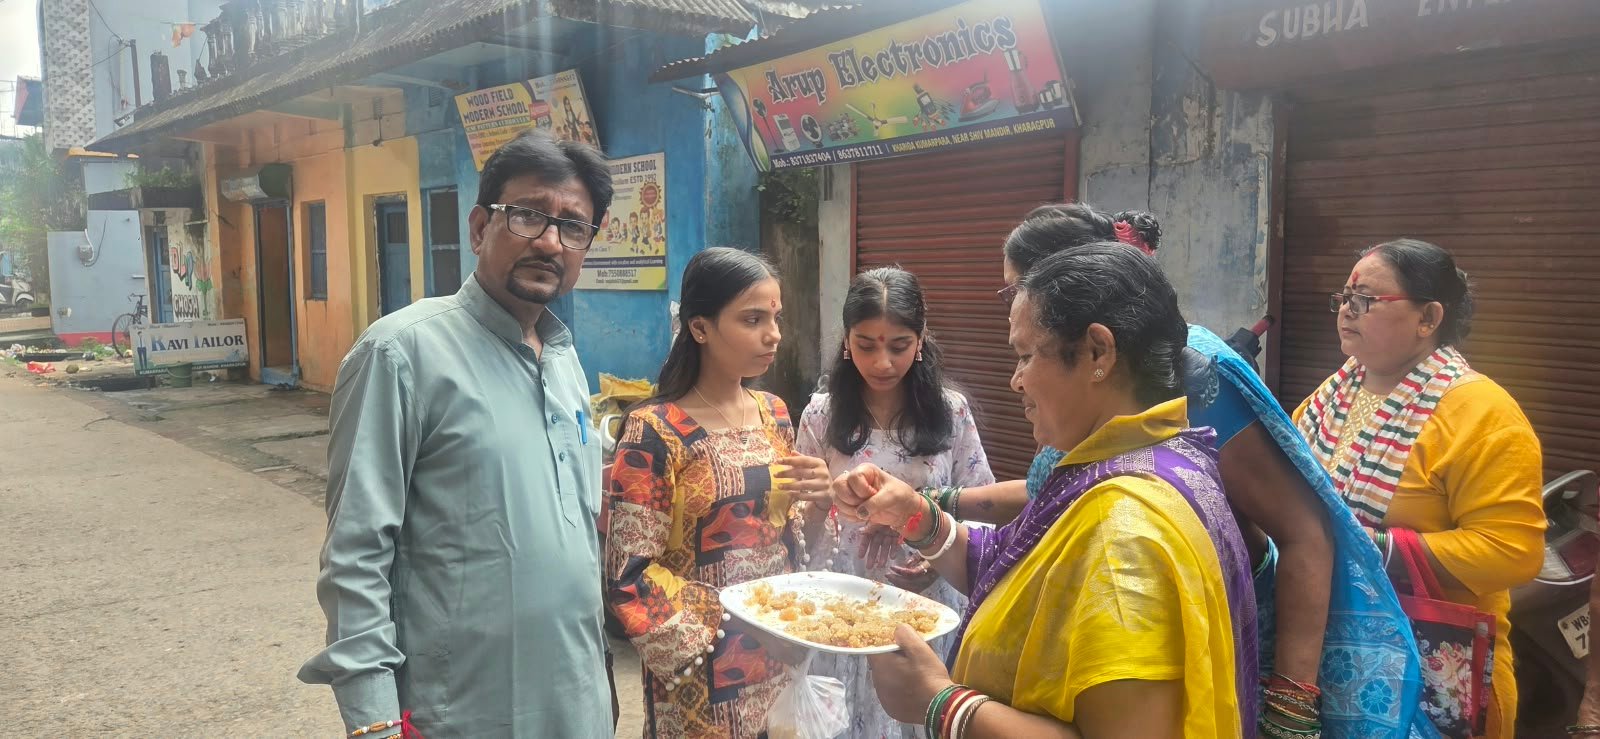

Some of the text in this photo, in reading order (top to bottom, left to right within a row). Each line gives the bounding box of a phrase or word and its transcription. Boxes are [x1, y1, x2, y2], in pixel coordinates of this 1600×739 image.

[1255, 0, 1368, 47] SUBHA
[765, 15, 1017, 105] Arup Electronics
[466, 88, 514, 108] WOOD FIELD
[463, 109, 496, 124] MODERN
[497, 100, 529, 118] SCHOOL
[791, 151, 831, 166] 8371837404
[836, 144, 883, 160] 8637811711
[952, 132, 970, 144] NEAR
[970, 129, 983, 142] SHIV
[1012, 117, 1056, 134] KHARAGPUR
[633, 159, 657, 172] SCHOOL
[150, 335, 189, 352] KAVI
